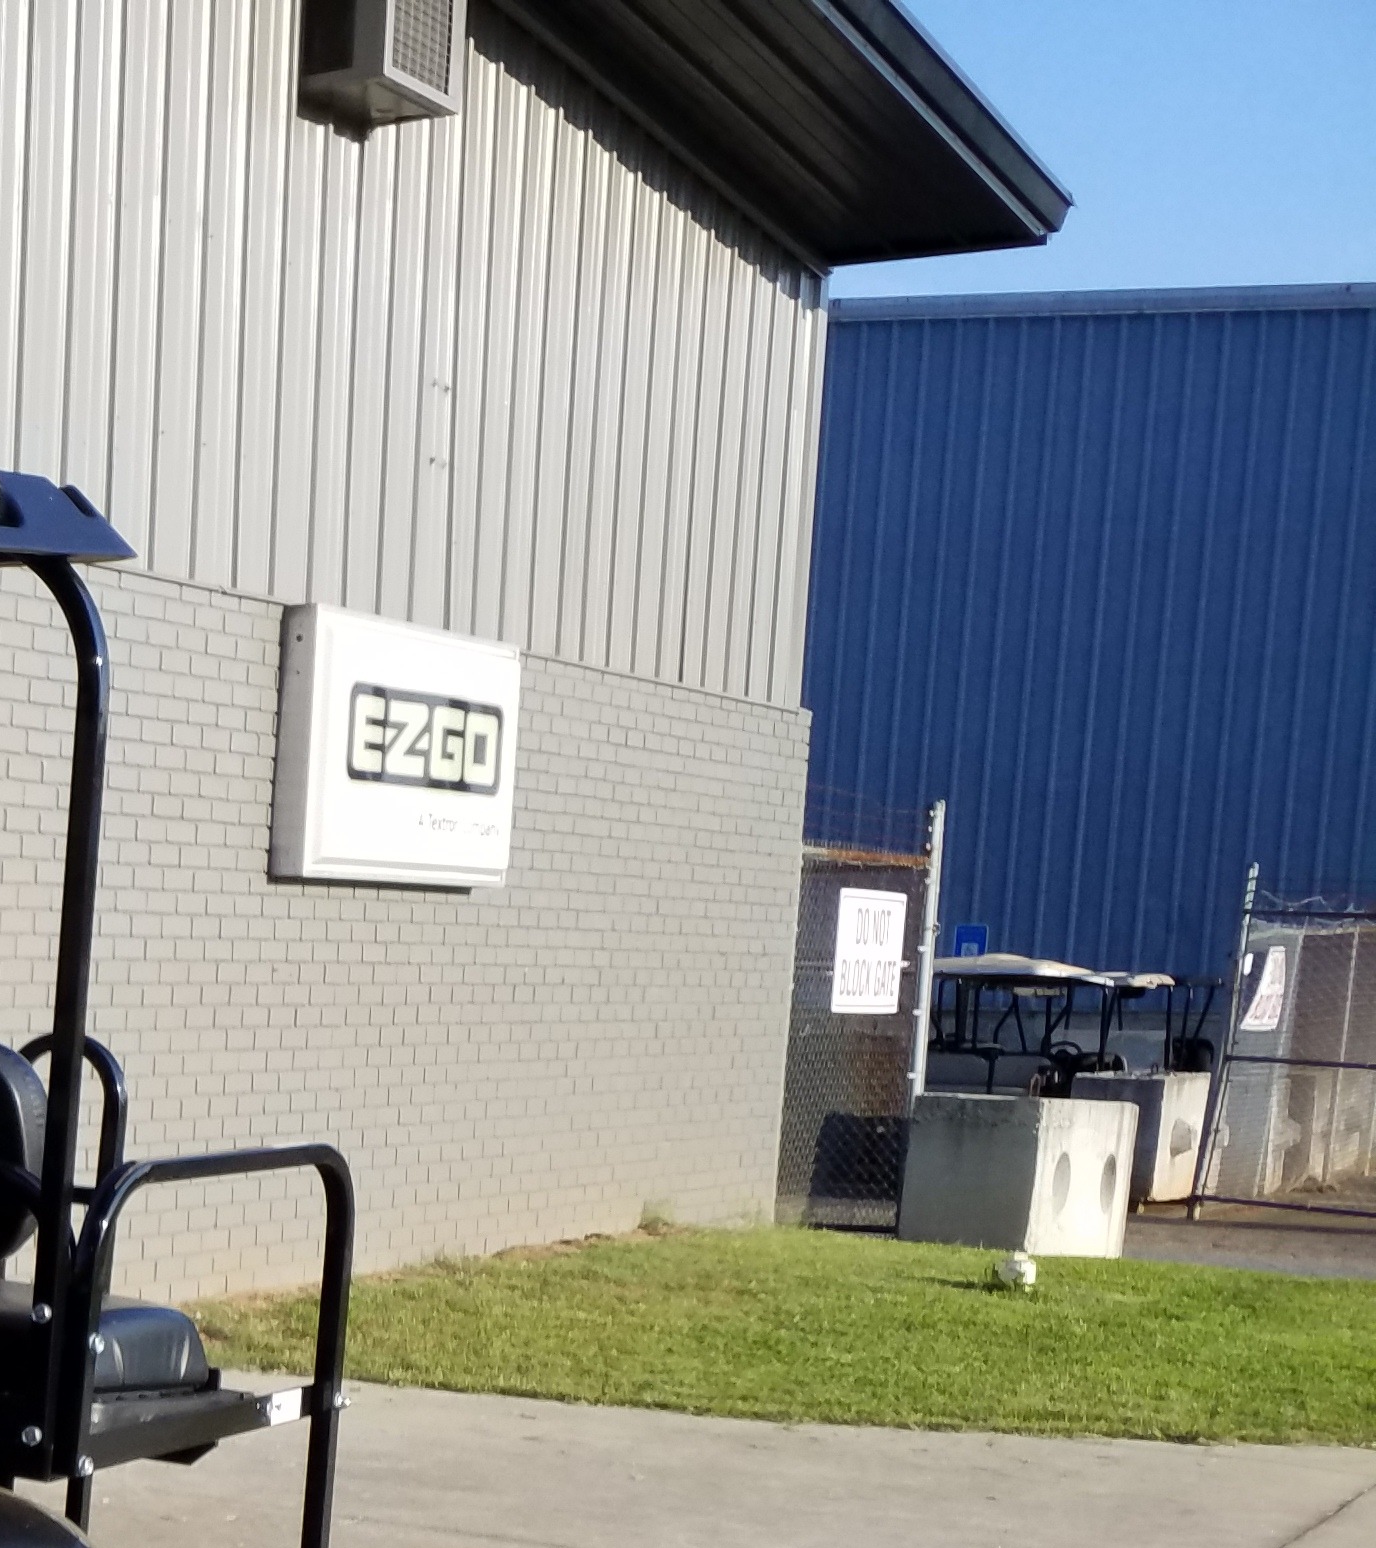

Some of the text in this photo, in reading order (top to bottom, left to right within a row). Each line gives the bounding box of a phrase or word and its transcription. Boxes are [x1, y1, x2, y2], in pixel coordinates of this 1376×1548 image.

[856, 908, 892, 946] DO NOT
[839, 959, 897, 996] BLOCK GATE
